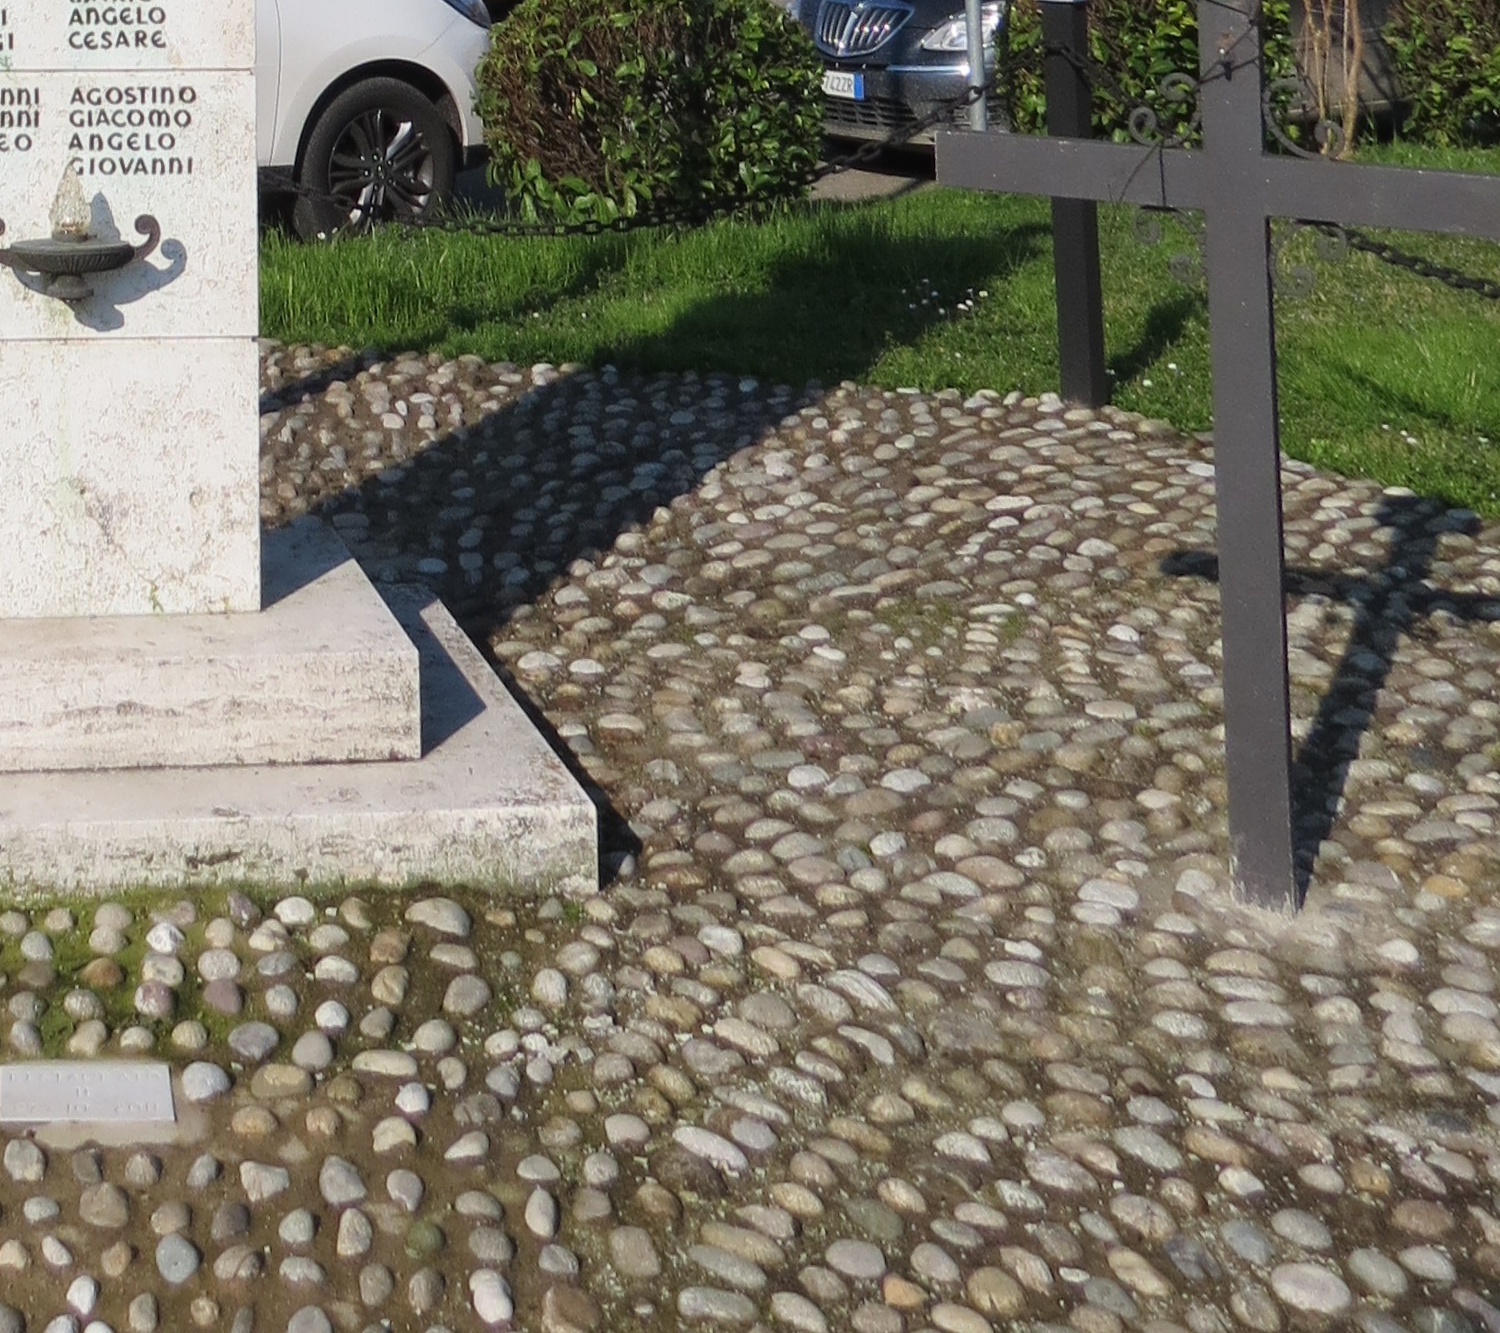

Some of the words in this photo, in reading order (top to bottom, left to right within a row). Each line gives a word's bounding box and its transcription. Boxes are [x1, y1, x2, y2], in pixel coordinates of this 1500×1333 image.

[69, 7, 166, 25] ANGELO
[68, 30, 166, 50] CESARE
[71, 87, 197, 106] AGOSTINO
[69, 109, 192, 128] GIACOMO
[69, 133, 176, 151] ANGELO
[70, 157, 193, 175] GIOVANNI
